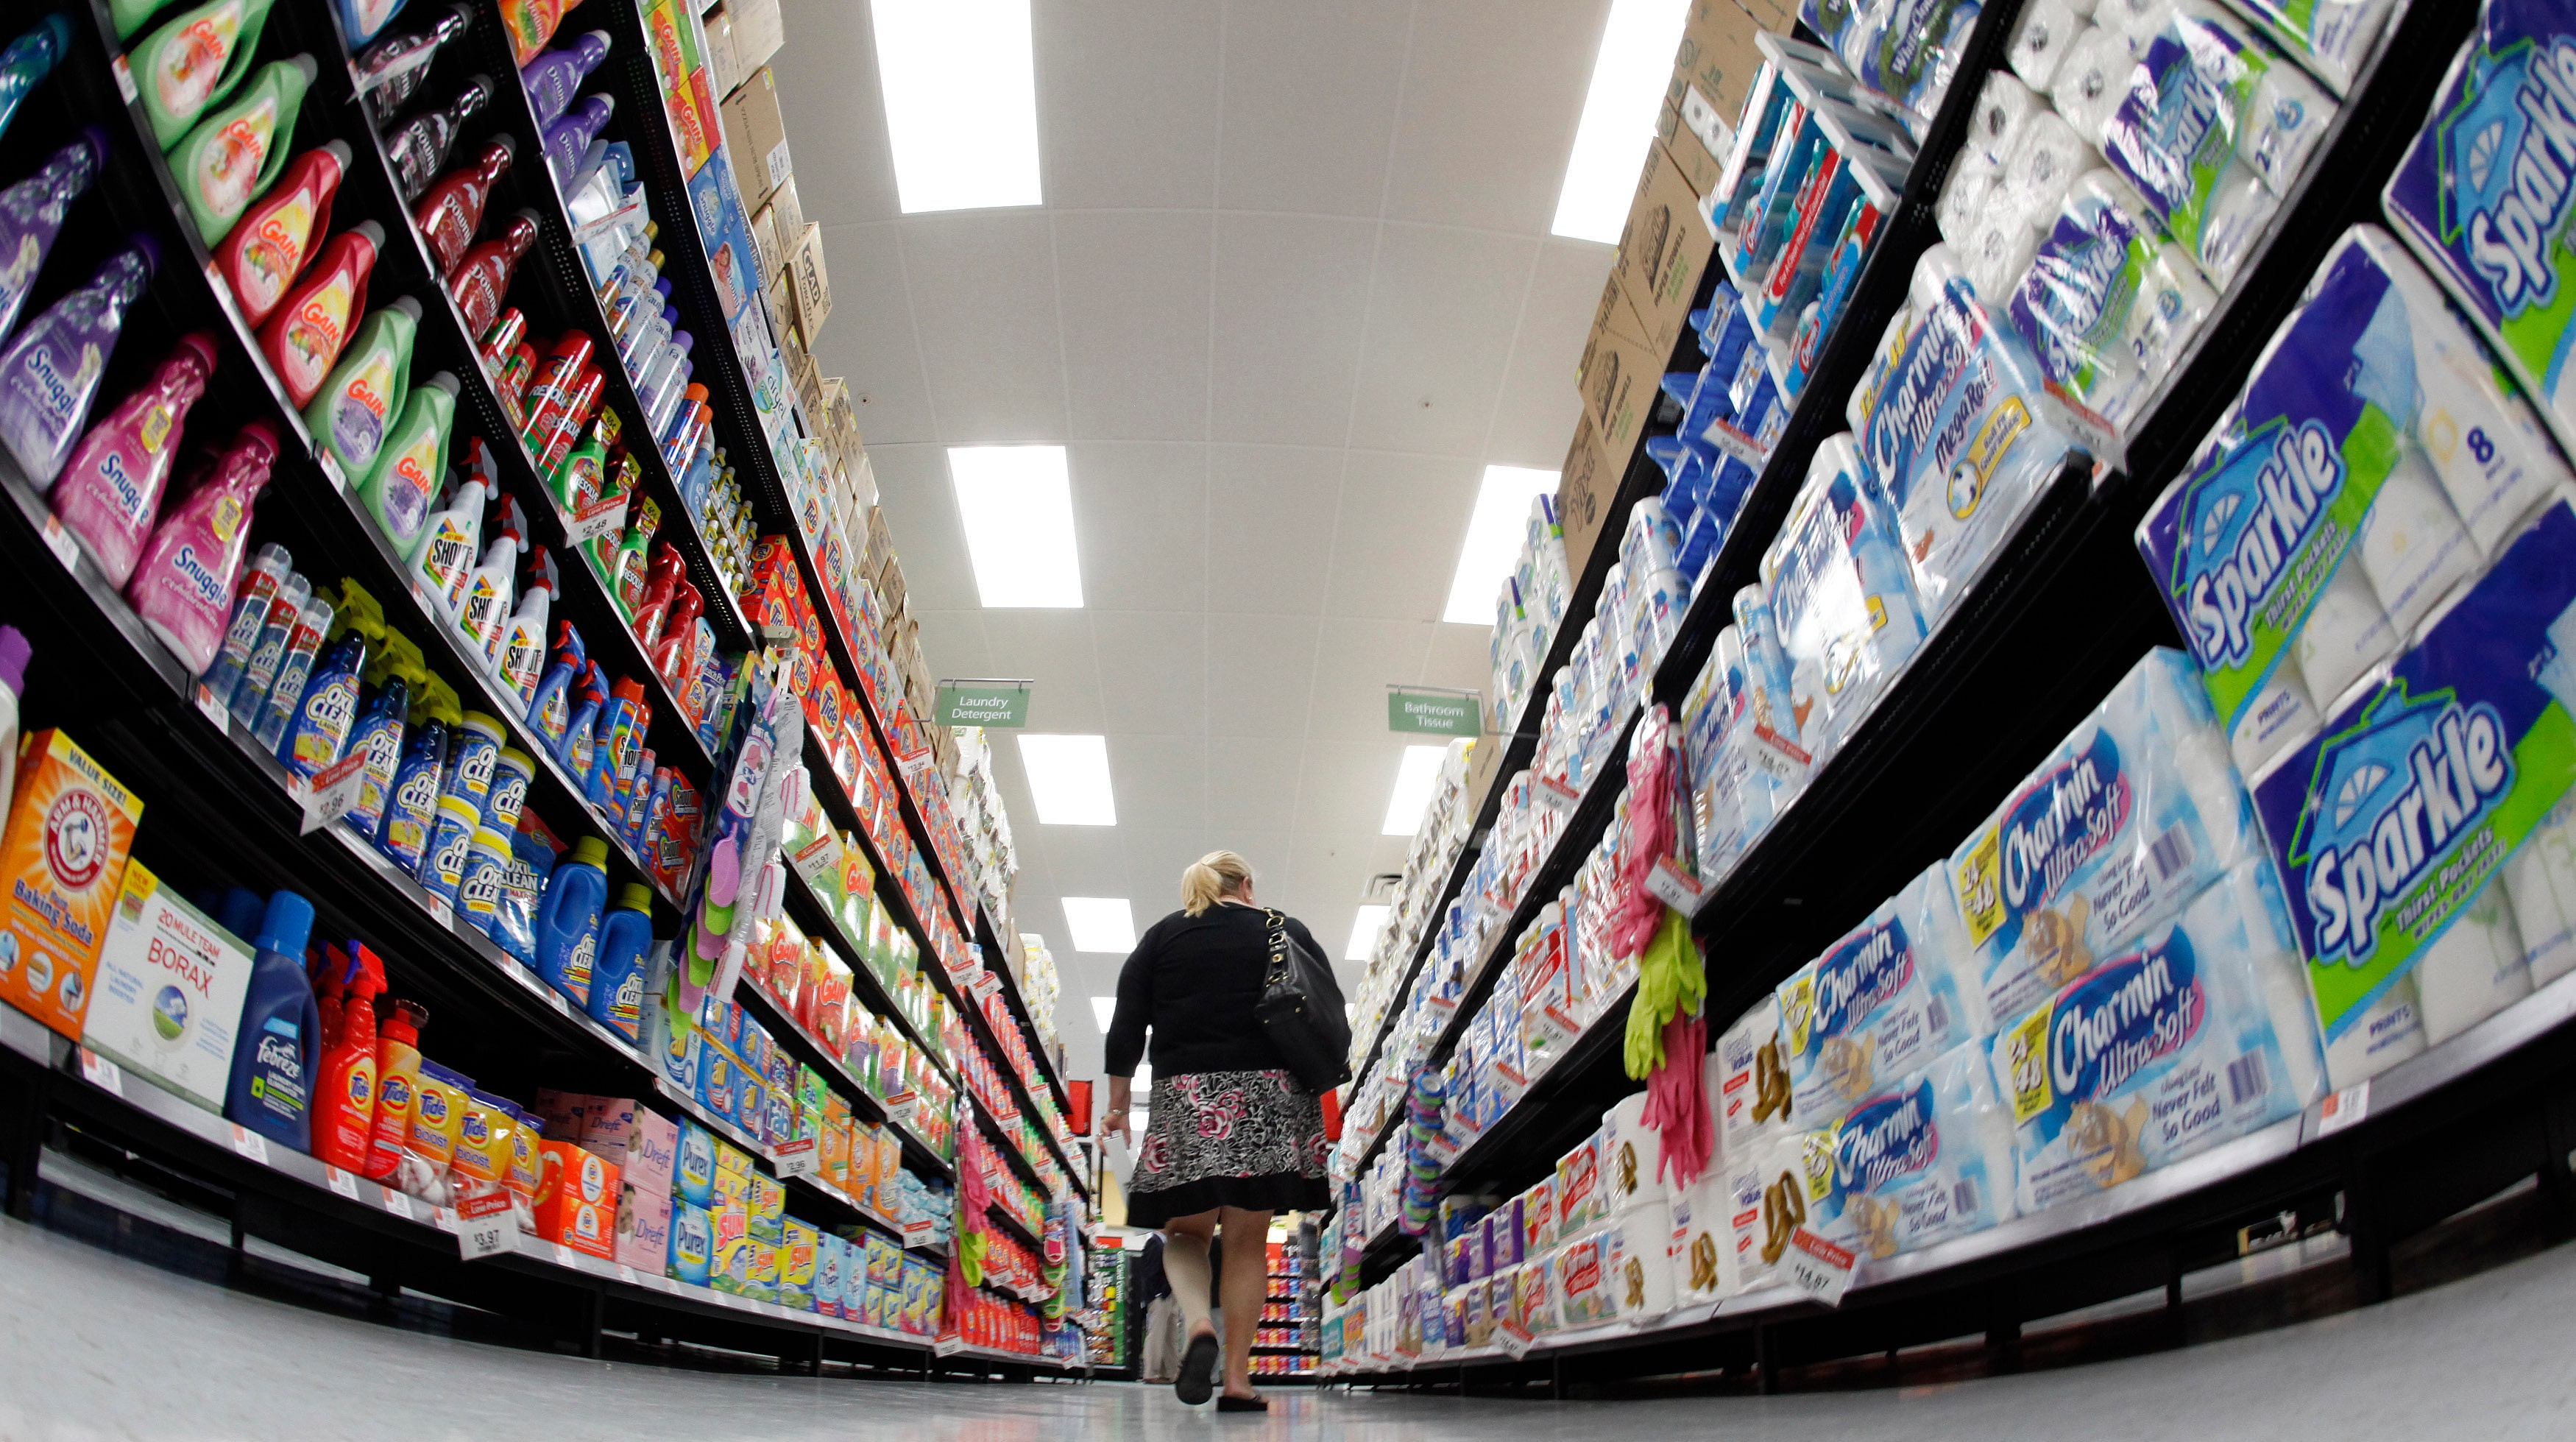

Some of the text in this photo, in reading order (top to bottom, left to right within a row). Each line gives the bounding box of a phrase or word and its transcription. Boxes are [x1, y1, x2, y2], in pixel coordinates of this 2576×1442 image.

[1874, 305, 1948, 482] Charmin
[2467, 425, 2494, 464] 8
[804, 503, 818, 531] Tide
[756, 544, 774, 561] Tide
[2190, 426, 2336, 663] Sparkle
[826, 545, 843, 576] Tide
[786, 568, 799, 592] Tide
[806, 621, 818, 643] Tide
[794, 664, 809, 687] Tide
[819, 693, 839, 729] Tide
[952, 708, 1012, 721] Detergent
[960, 696, 1008, 709] Laundry
[1405, 701, 1464, 717] Bathroom
[1416, 715, 1454, 729] Tissue
[366, 749, 398, 774] LEAN
[69, 748, 127, 807] VALUE SIZE!
[50, 796, 72, 834] ARM
[2005, 754, 2102, 908] Charmin
[2310, 712, 2504, 955] Sparkle
[2439, 827, 2494, 893] Pockets
[14, 878, 60, 929] Baking
[63, 912, 93, 947] Soda
[158, 907, 221, 958] 20 MULE TEAM
[147, 938, 214, 999] BORAX
[1816, 927, 1894, 1034] Charmin
[2053, 949, 2175, 1097] Charmin
[381, 1080, 410, 1103] Tide
[419, 1090, 447, 1117] Tide
[2152, 1086, 2189, 1124] Never
[461, 1113, 487, 1137] Tide
[766, 1102, 792, 1142] Fab
[2182, 1103, 2223, 1134] Good
[413, 1123, 448, 1150] boost
[1837, 1094, 1923, 1187] Charmin
[454, 1145, 491, 1169] boost
[682, 1138, 711, 1170] Purex
[473, 1229, 500, 1246] $3.97
[676, 1228, 707, 1258] Purex
